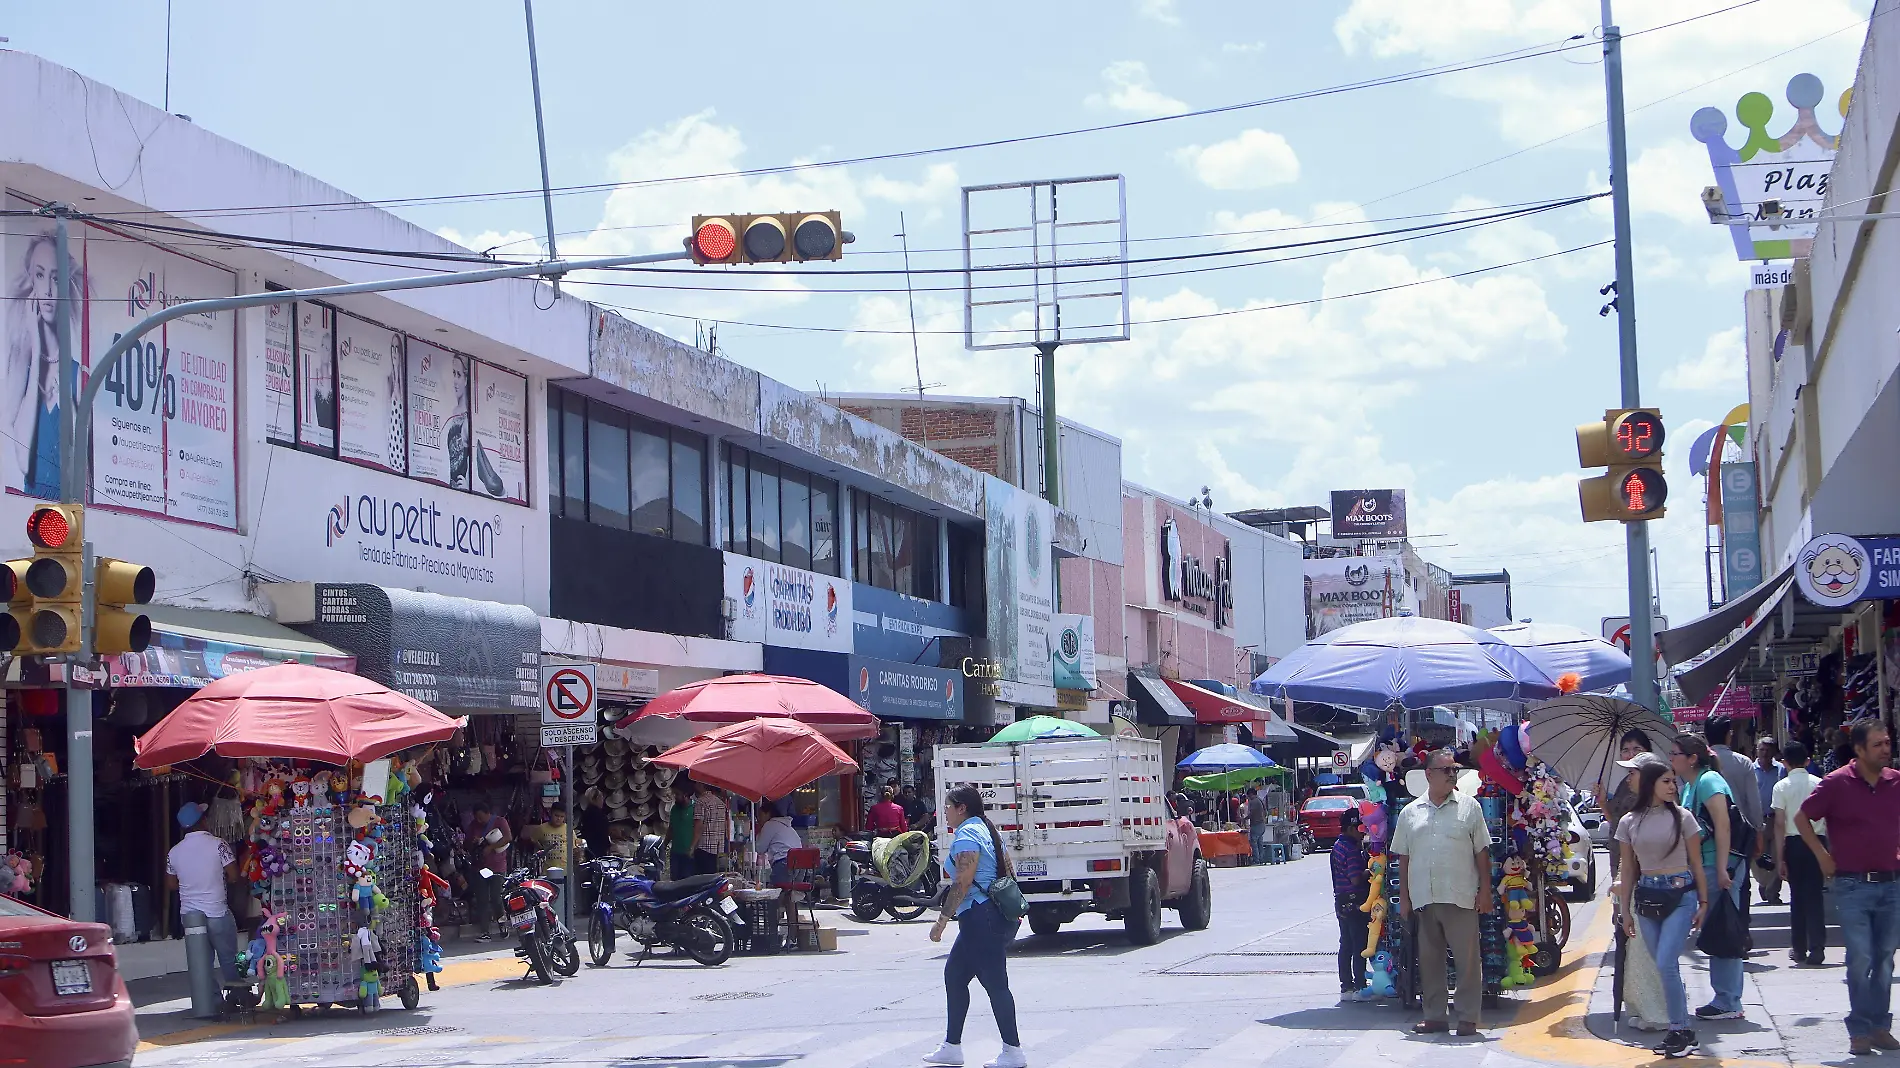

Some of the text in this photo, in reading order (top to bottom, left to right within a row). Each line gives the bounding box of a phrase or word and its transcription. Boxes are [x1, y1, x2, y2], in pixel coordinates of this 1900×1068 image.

[1755, 268, 1779, 284] más
[181, 351, 227, 383] DE UTILIDAD
[105, 333, 175, 419] 40%
[181, 378, 226, 403] EN COMPRAS AL
[181, 397, 227, 432] MAYOREO
[1617, 422, 1651, 451] 92
[358, 494, 387, 536] au
[392, 497, 442, 549] petit
[1366, 514, 1393, 522] BOOTS
[358, 541, 381, 563] Tienda
[382, 550, 391, 565] de
[421, 554, 449, 576] Precios
[450, 563, 456, 575] a
[456, 561, 494, 583] Mayoristas
[1874, 548, 1900, 565] FAR
[322, 589, 348, 597] CINTOS
[770, 565, 814, 605] CARNITAS
[322, 597, 357, 606] CARTERAS
[1320, 591, 1349, 602] MAX
[322, 606, 350, 614] GORRAS
[773, 600, 812, 633] RODRIGO
[321, 614, 367, 623] PORTAFOLIOS
[522, 652, 538, 664] CINTOS
[124, 675, 138, 684] 477
[516, 667, 537, 680] CARTERAS
[880, 671, 938, 692] CARNITAS RODRIGO
[544, 726, 594, 737] SOLO ASCENSO
[554, 734, 590, 743] DESCENSO
